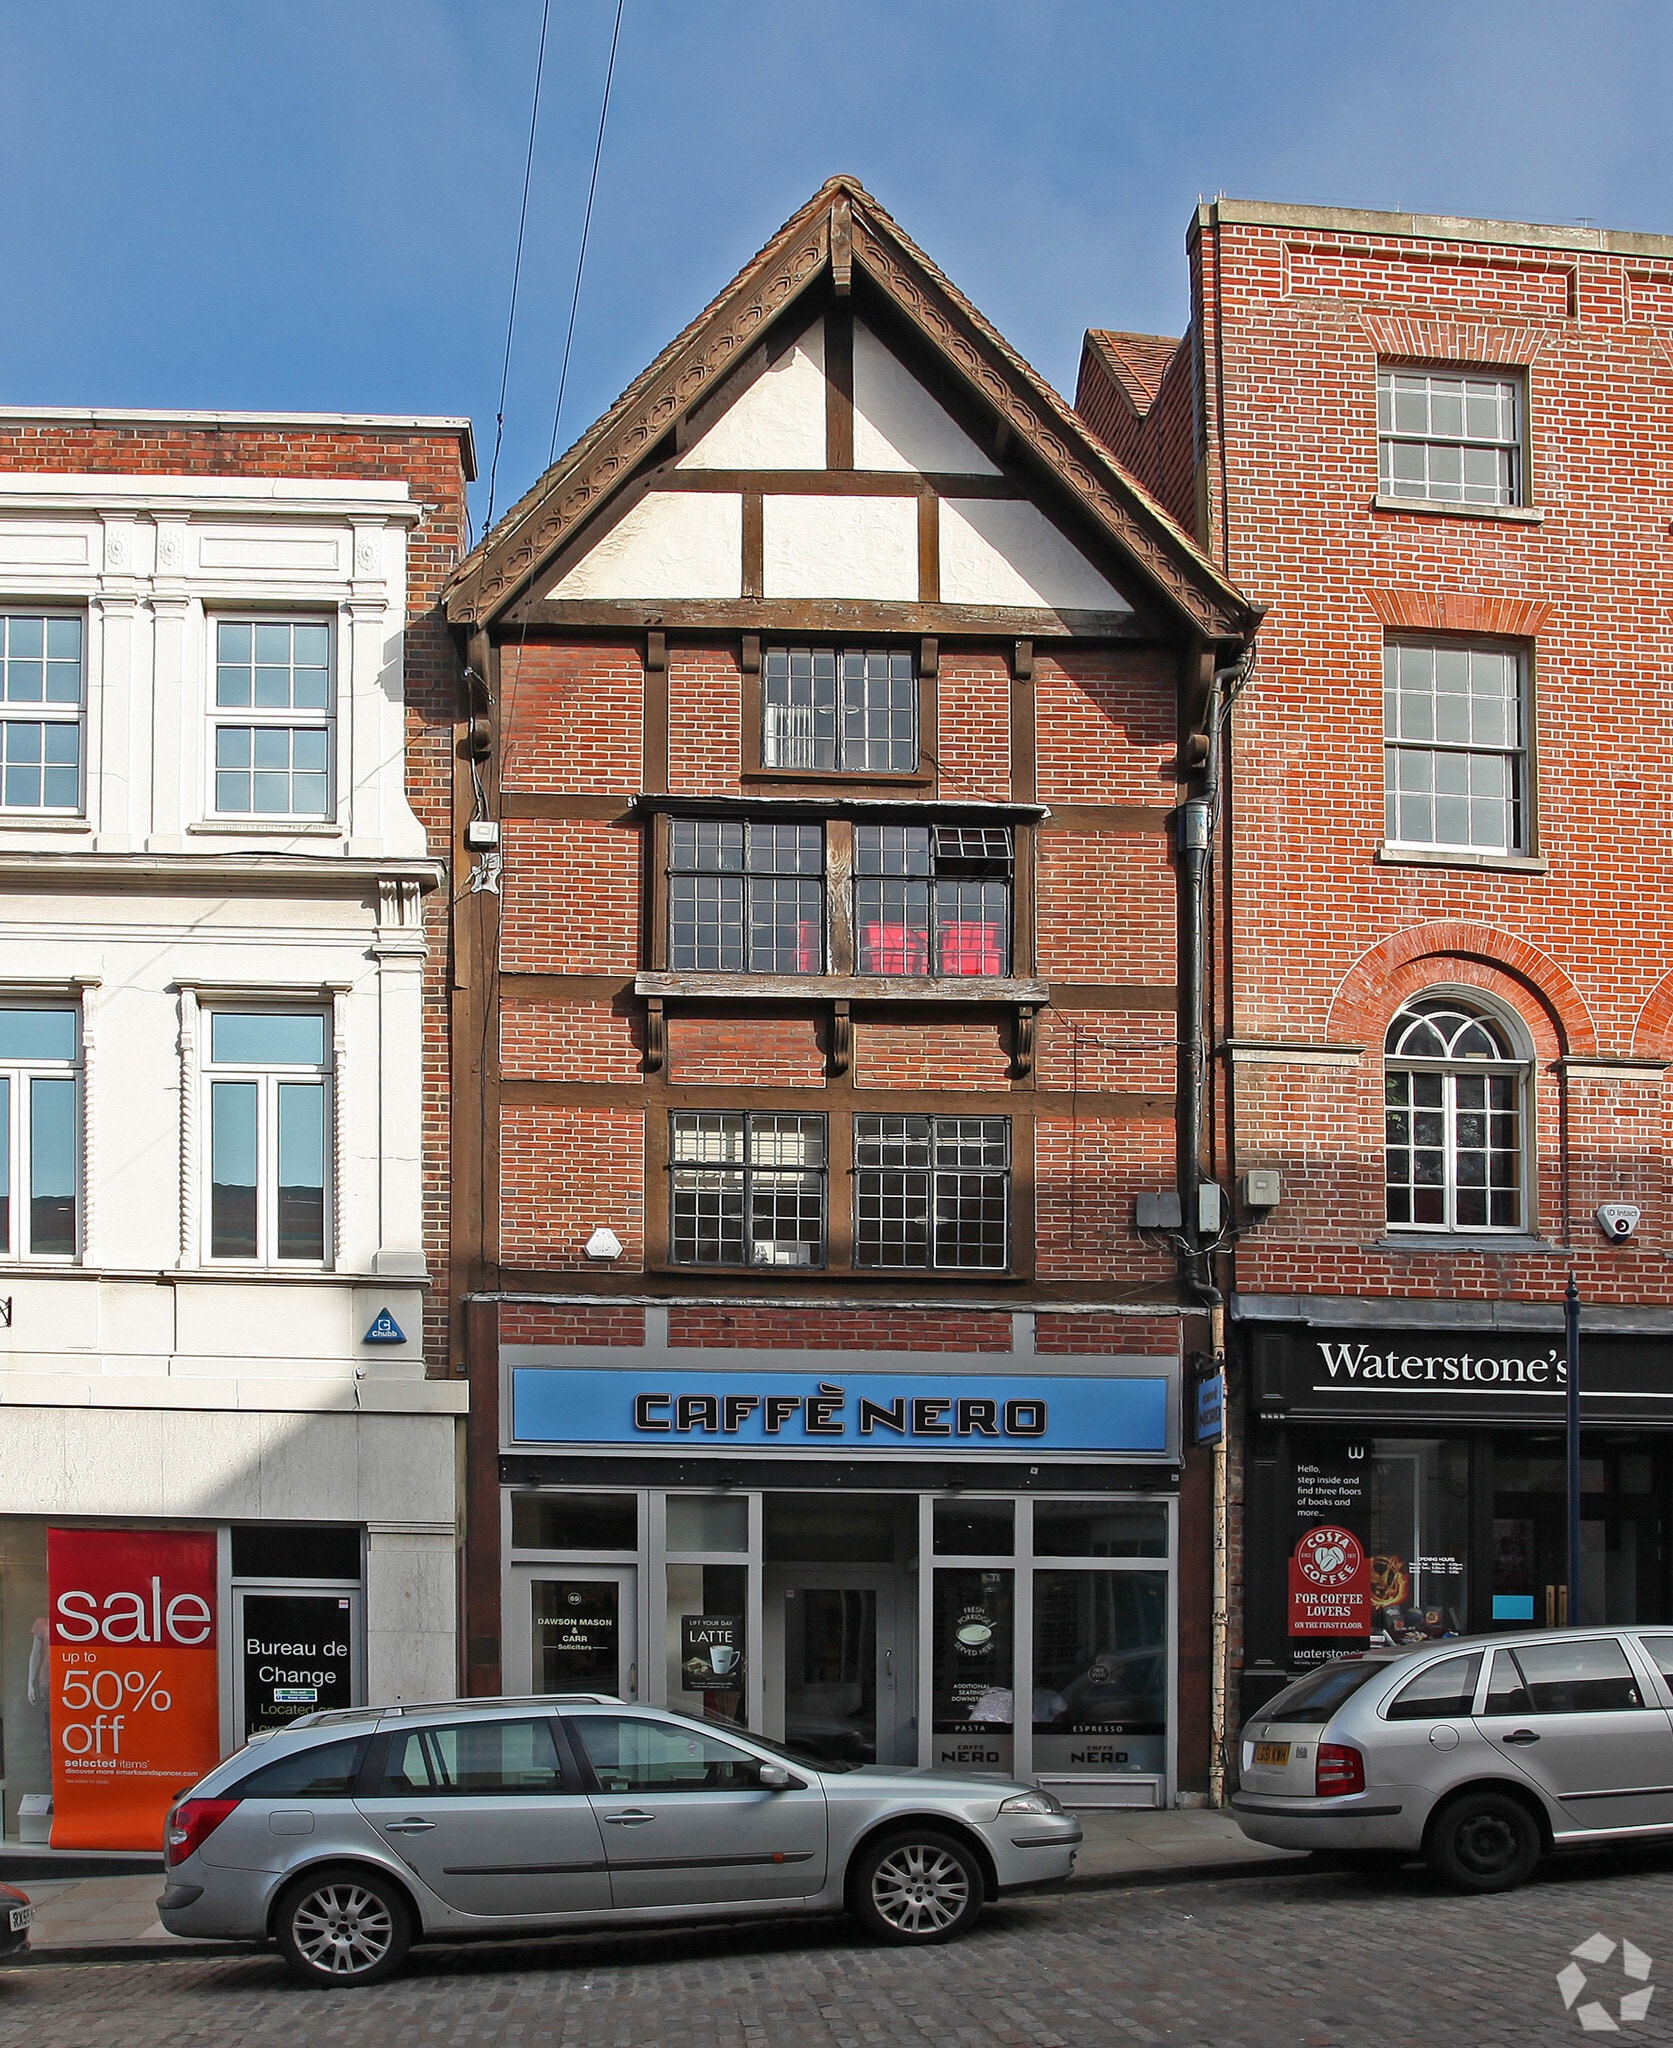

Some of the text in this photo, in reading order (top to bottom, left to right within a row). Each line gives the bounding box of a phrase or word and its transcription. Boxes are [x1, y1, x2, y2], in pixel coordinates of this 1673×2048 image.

[1316, 1342, 1567, 1384] Waterstone's
[859, 1396, 1048, 1437] NERO
[1297, 1465, 1321, 1474] Hello,
[1297, 1476, 1315, 1485] step
[1317, 1476, 1341, 1484] inside
[1297, 1486, 1361, 1495] find three floors
[1297, 1497, 1306, 1506] of
[1308, 1498, 1333, 1506] books
[1306, 1532, 1351, 1549] COSTA
[1304, 1563, 1354, 1584] COFFEE
[1294, 1593, 1363, 1604] FOR COFFEE
[56, 1576, 212, 1644] sale
[963, 1606, 985, 1614] FRESH
[1306, 1606, 1351, 1617] LOVERS
[690, 1630, 733, 1643] LATTE
[246, 1638, 348, 1656] Bureau de
[953, 1641, 995, 1656] SERVED HERE
[62, 1652, 97, 1664] up to
[259, 1666, 336, 1688] Change
[62, 1670, 172, 1712] 50%
[260, 1703, 314, 1716] Located
[62, 1714, 126, 1754] off
[65, 1758, 117, 1768] selected
[941, 1751, 999, 1764] NERO
[1070, 1752, 1129, 1764] NERO
